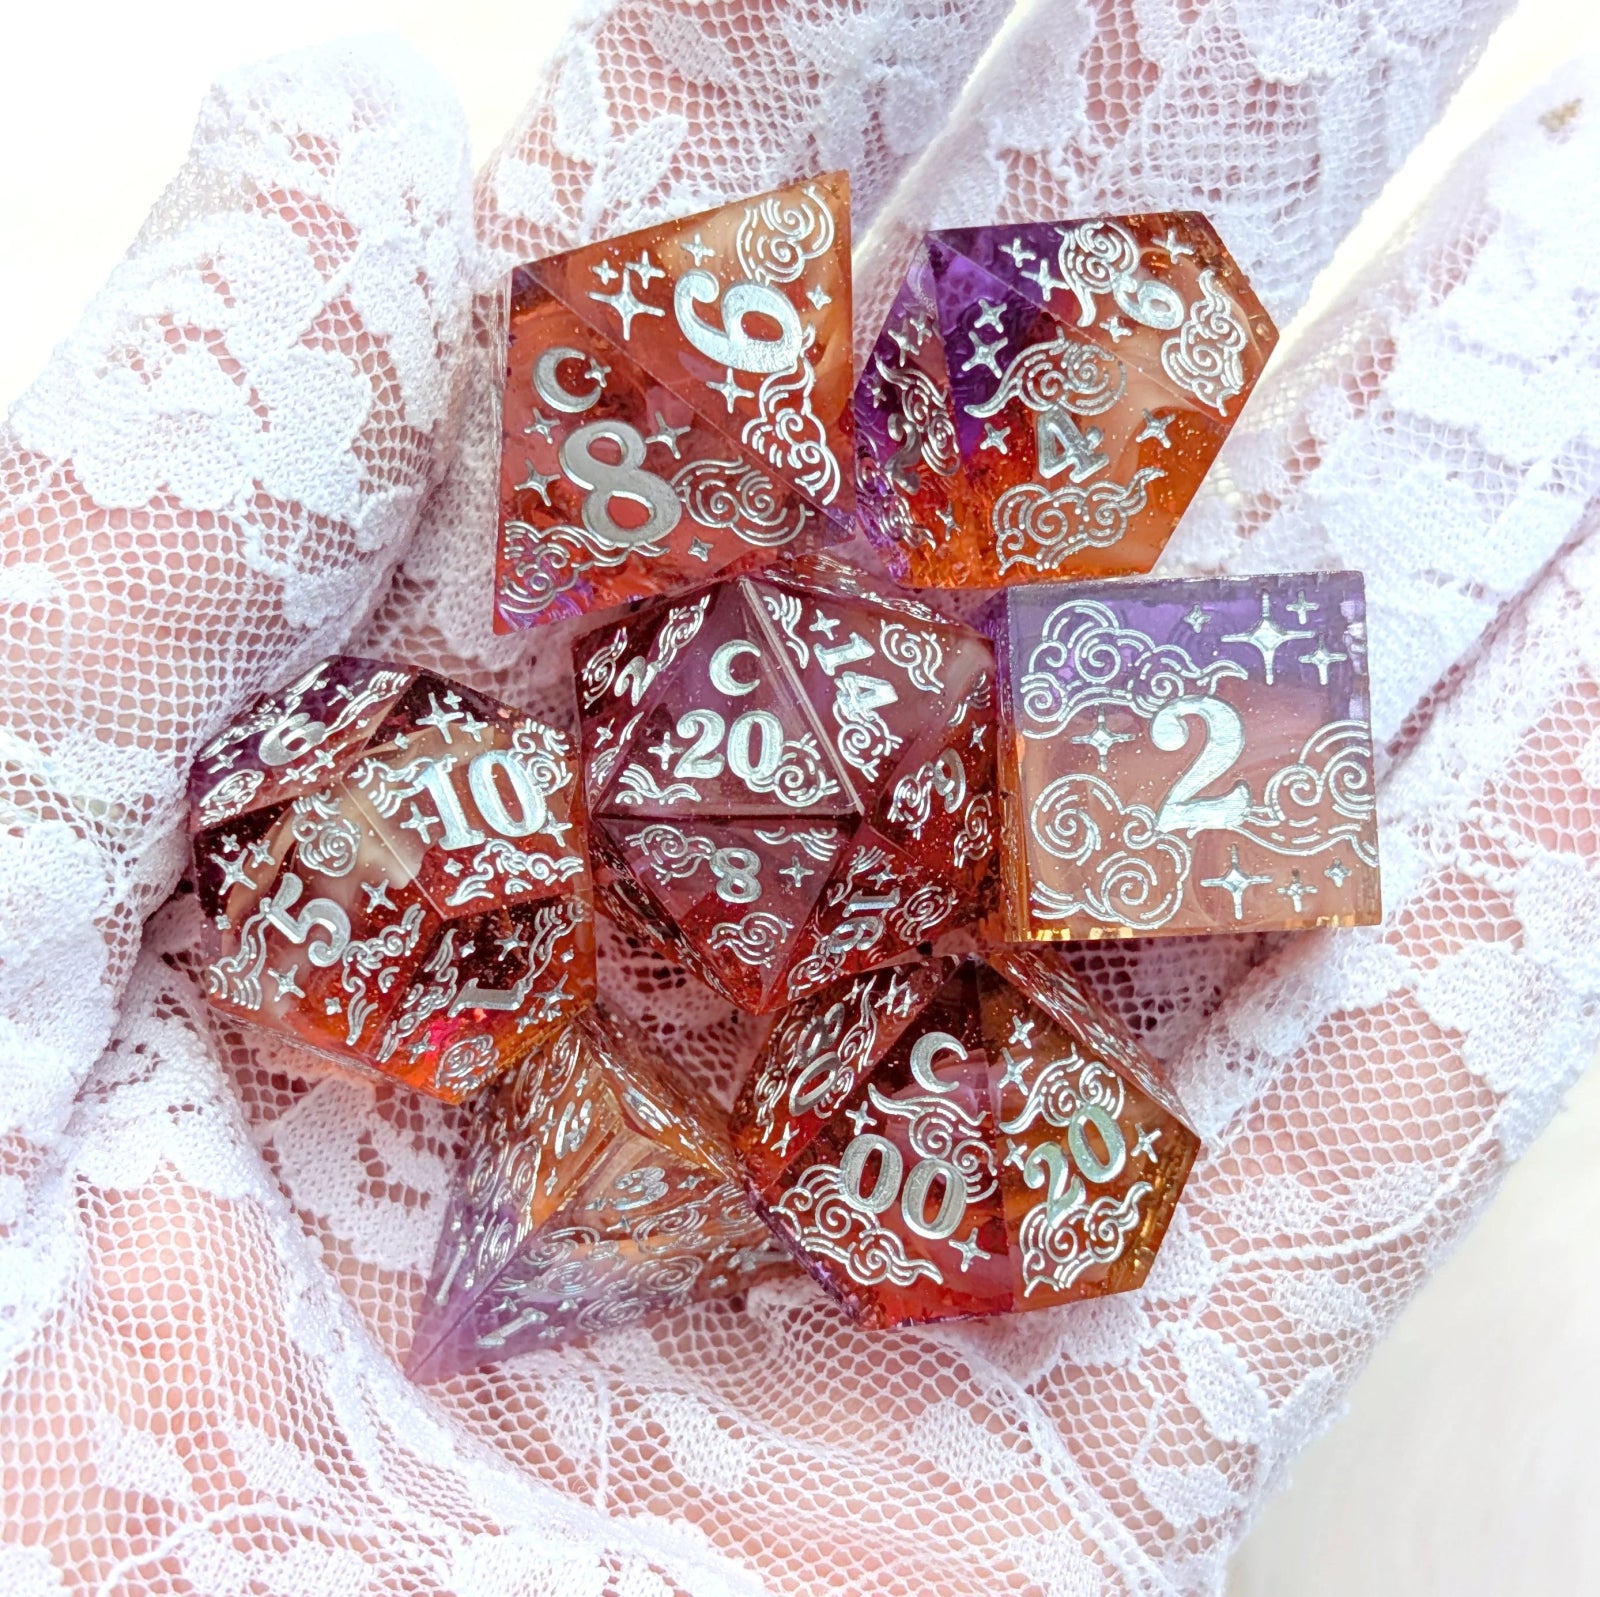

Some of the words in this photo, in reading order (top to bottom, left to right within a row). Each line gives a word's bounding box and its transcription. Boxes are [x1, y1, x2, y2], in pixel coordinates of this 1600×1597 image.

[673, 268, 803, 374] 6
[559, 419, 683, 545] 8
[1037, 409, 1110, 484] 4
[813, 633, 899, 715] 14
[674, 708, 785, 781] 20
[1149, 694, 1254, 834] 2
[416, 748, 549, 852] 10
[262, 872, 352, 968] 5
[709, 847, 763, 904] 8
[839, 1131, 970, 1241] 00
[1022, 1101, 1129, 1230] 20
